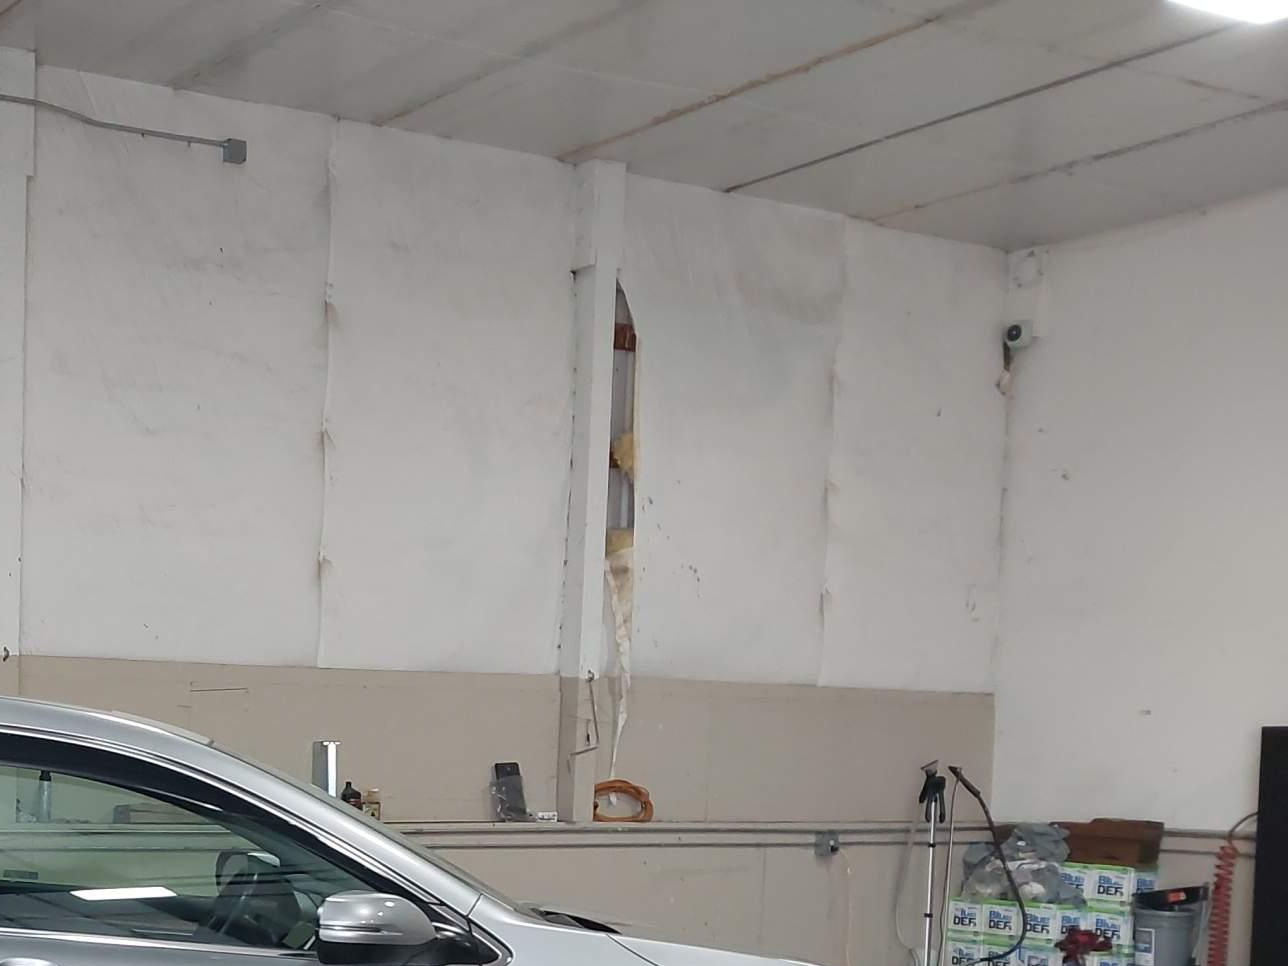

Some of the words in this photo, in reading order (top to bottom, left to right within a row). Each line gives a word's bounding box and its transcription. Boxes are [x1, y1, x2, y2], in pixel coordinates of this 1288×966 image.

[1098, 876, 1123, 886] Blue
[1097, 885, 1123, 896] DEF
[953, 908, 976, 917] lue
[989, 911, 1012, 921] Blue
[953, 916, 976, 927] DEF
[1026, 913, 1050, 924] Blue
[1096, 918, 1120, 929] Blue
[989, 920, 1012, 930] DEF
[1026, 923, 1049, 934] DEF
[1096, 928, 1120, 940] DEF
